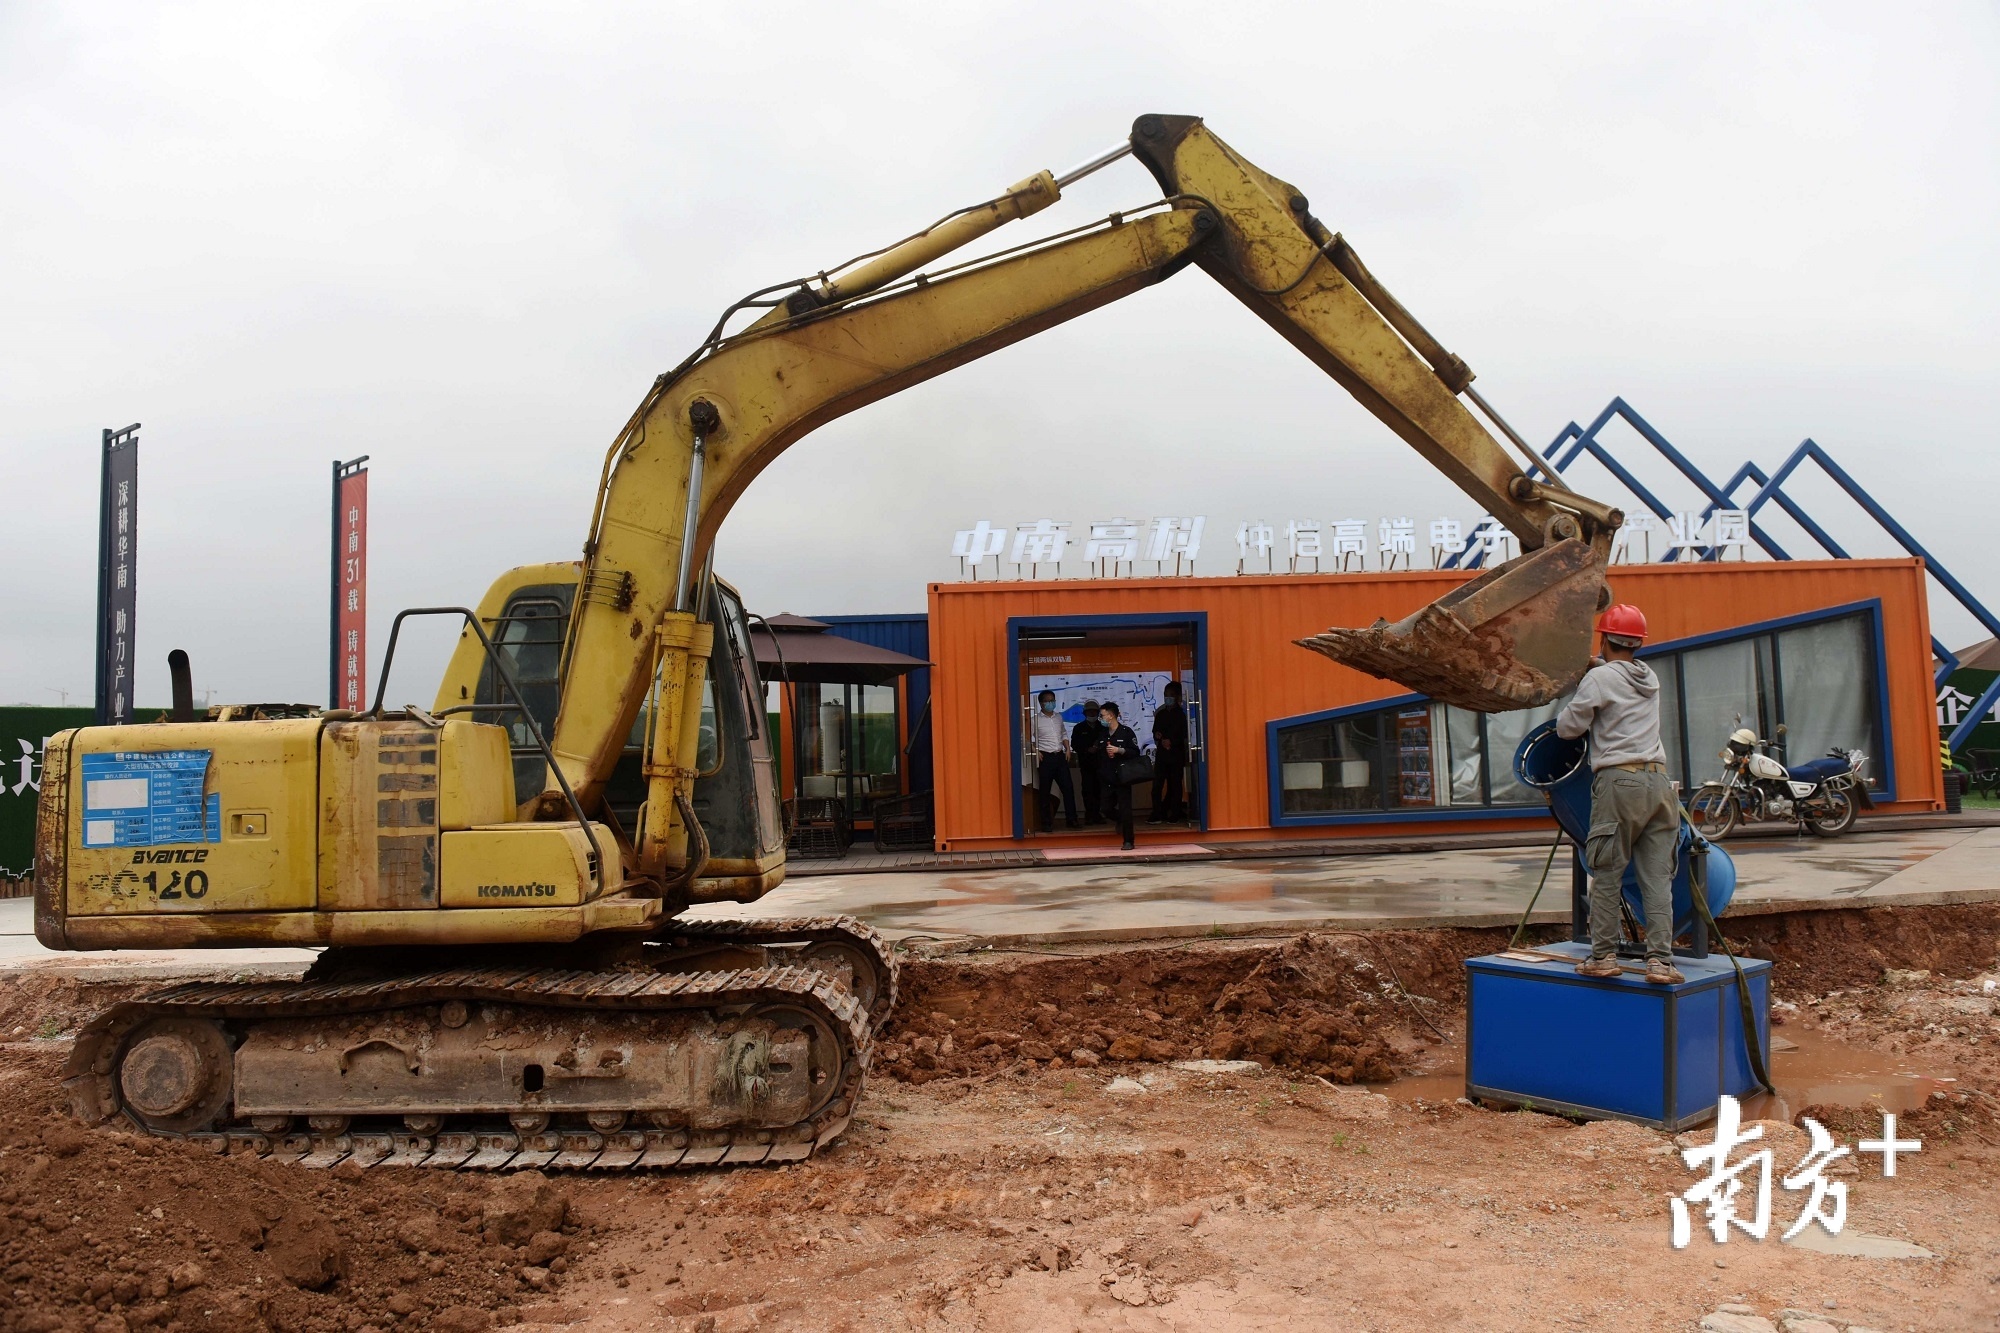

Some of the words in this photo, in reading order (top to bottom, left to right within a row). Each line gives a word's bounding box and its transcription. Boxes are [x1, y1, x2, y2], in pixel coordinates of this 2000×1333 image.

[117, 480, 129, 590] 深耕华南
[347, 506, 359, 612] 中南31载
[1235, 509, 1750, 559] 仲恺高端电子产业园
[114, 608, 126, 726] 助力产业
[478, 882, 556, 897] KOMATSU
